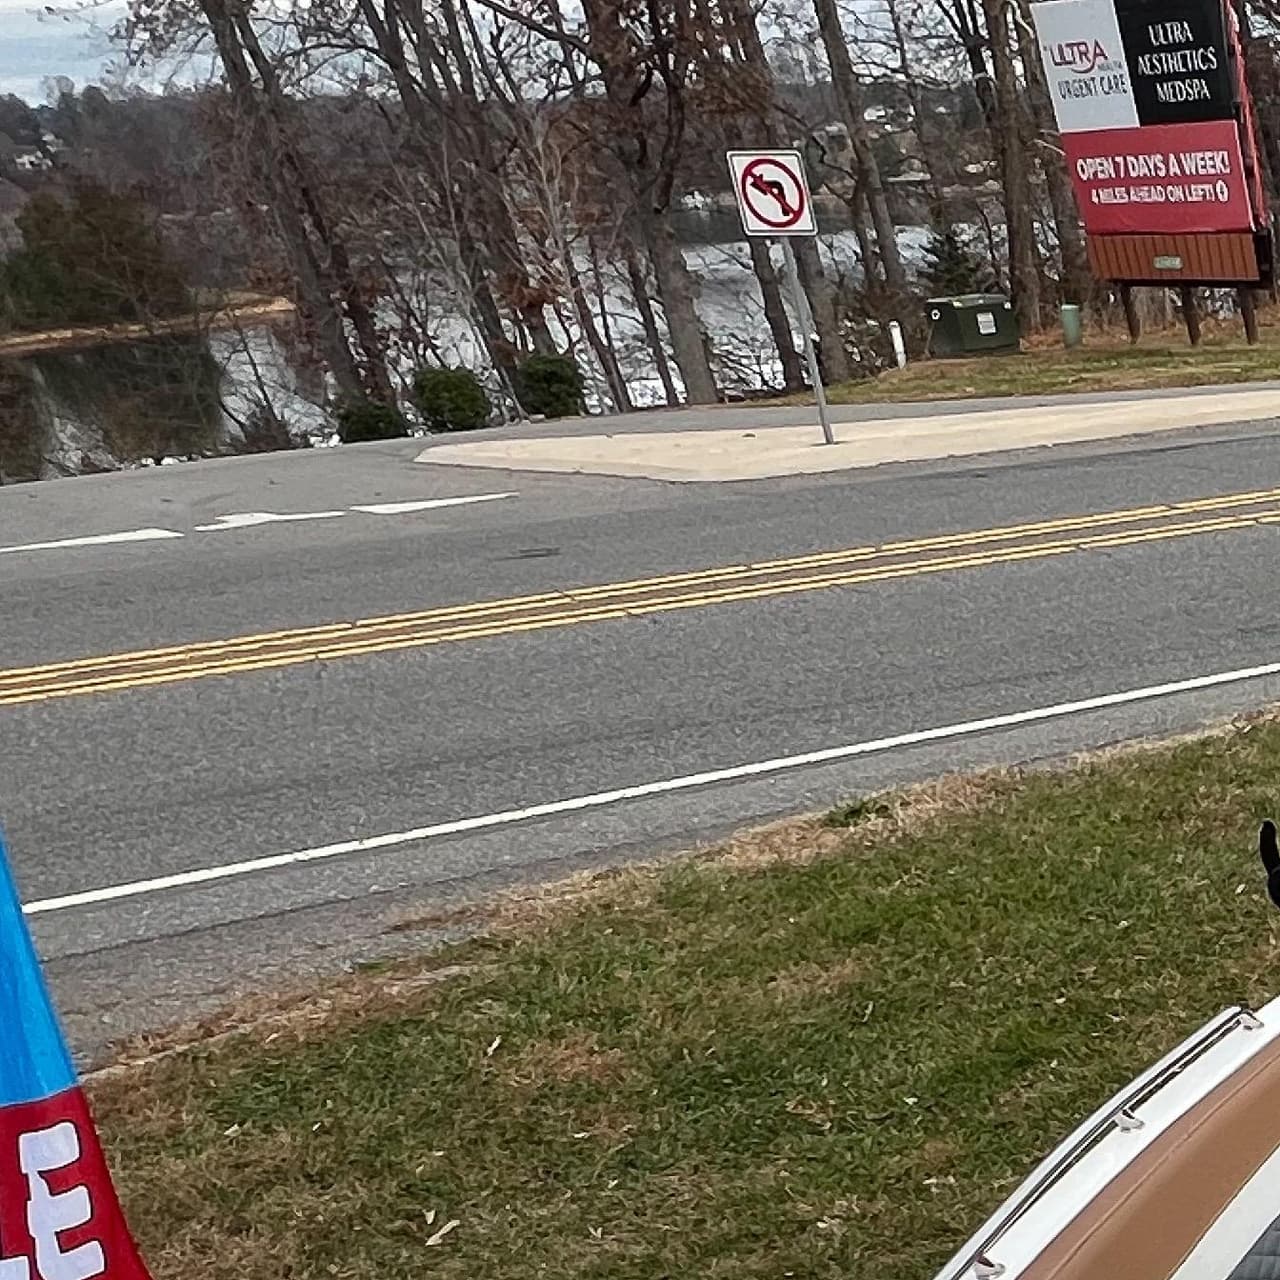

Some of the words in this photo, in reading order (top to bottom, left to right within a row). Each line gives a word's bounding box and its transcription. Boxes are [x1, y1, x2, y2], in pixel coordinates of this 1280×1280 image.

[1148, 20, 1194, 46] ULTRA
[1050, 40, 1108, 70] ULTRA
[1137, 46, 1217, 76] AESTHETICS
[1058, 76, 1099, 100] URGENT
[1099, 73, 1128, 95] CARE
[1156, 78, 1211, 103] MEDSPA
[1076, 156, 1116, 181] OPEN
[1115, 156, 1125, 179] 7
[1127, 153, 1166, 178] DAYS
[1168, 153, 1181, 177] A
[1180, 151, 1230, 175] WEEK!
[1129, 186, 1165, 202] AHEAD
[1166, 185, 1184, 202] ON
